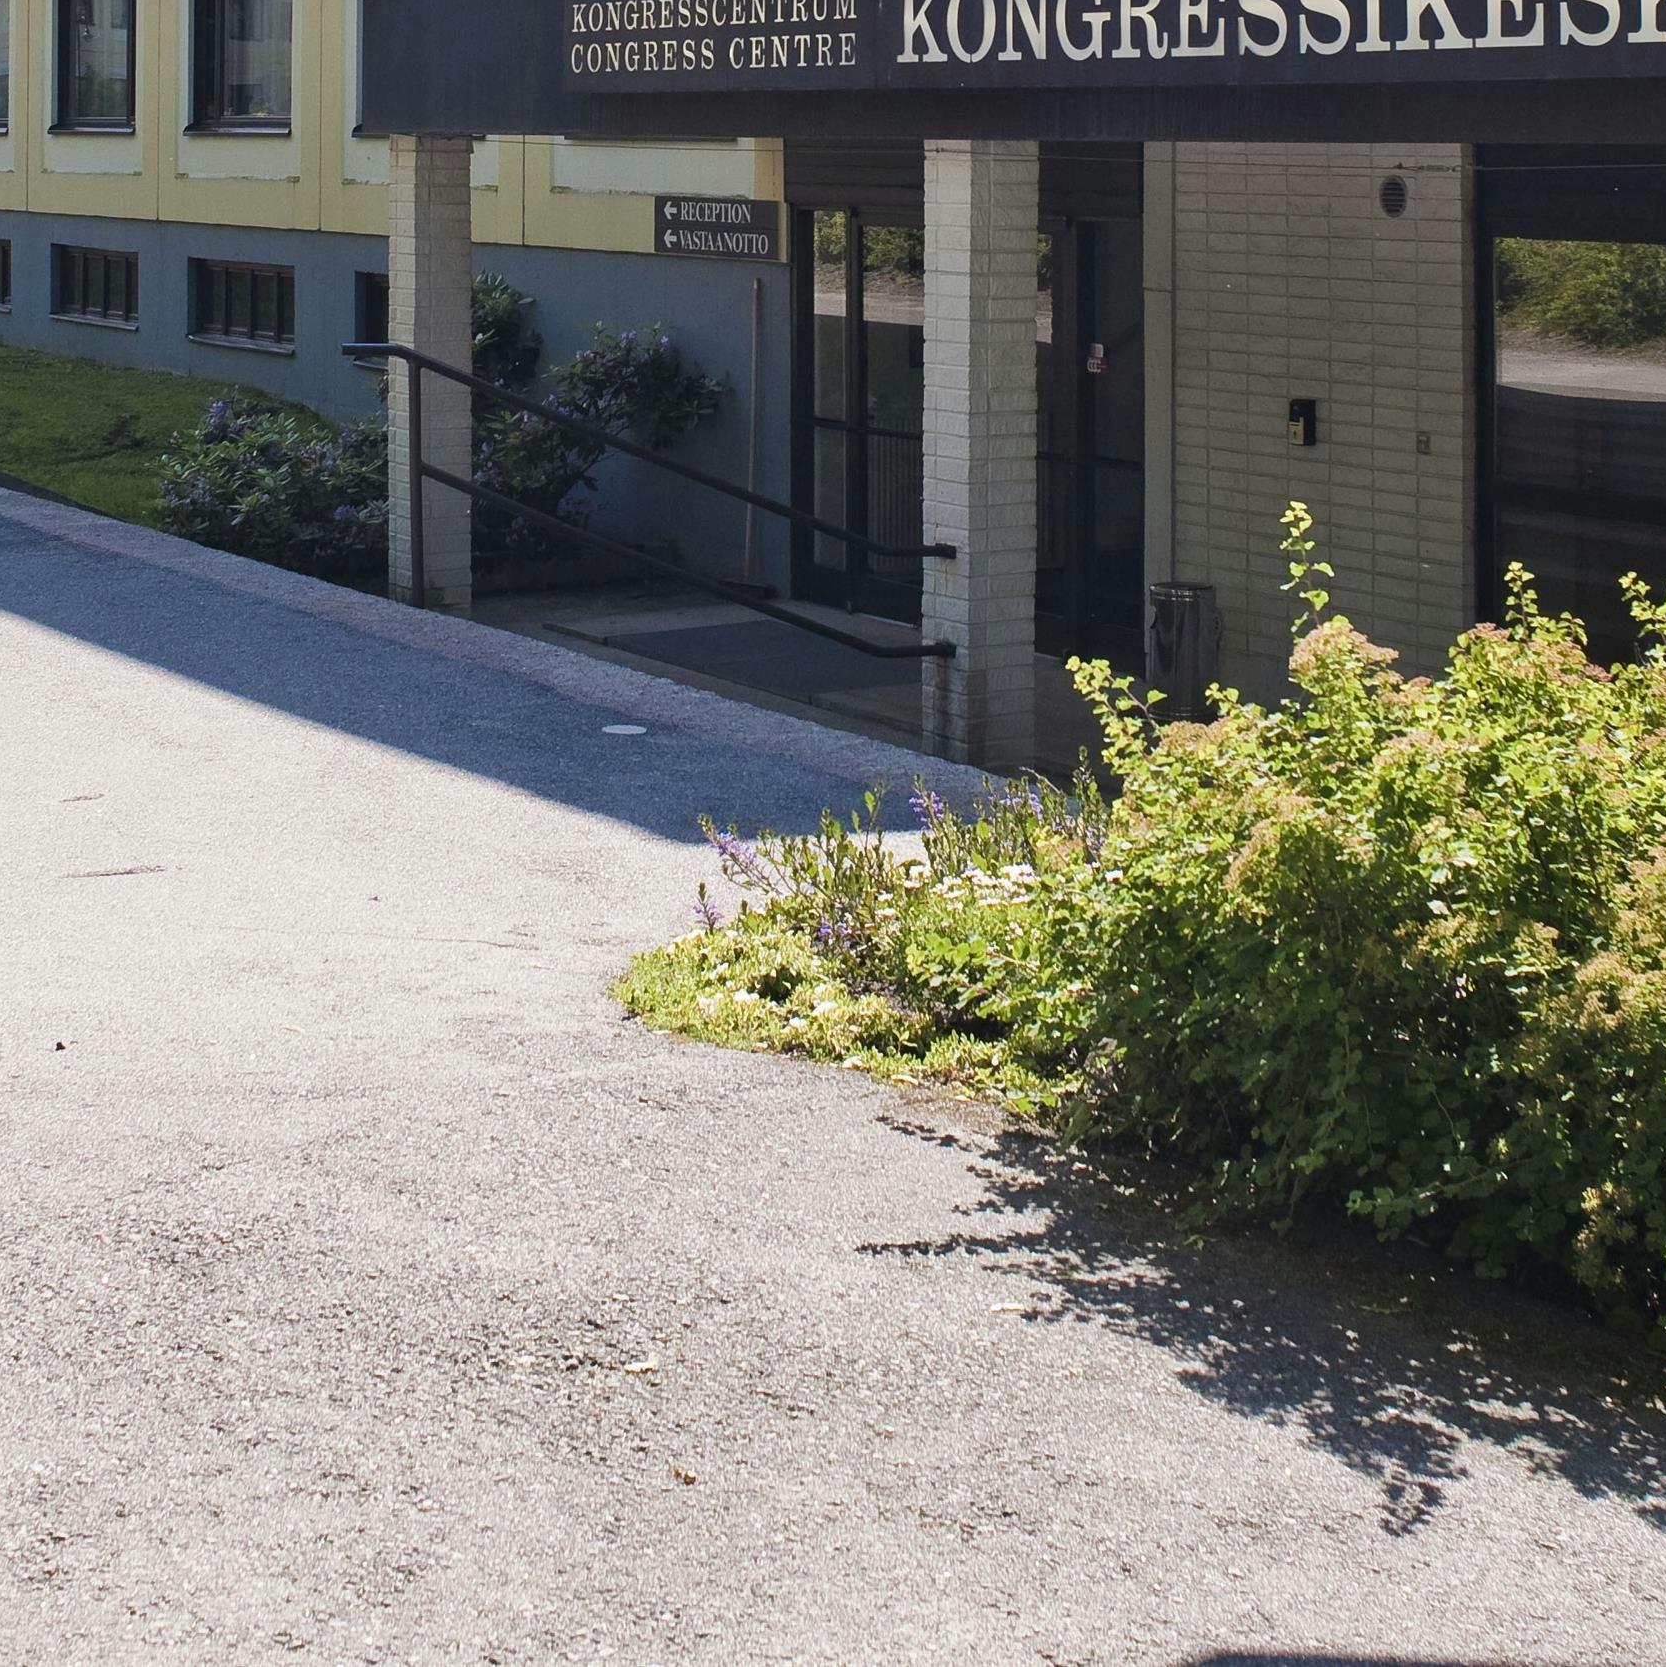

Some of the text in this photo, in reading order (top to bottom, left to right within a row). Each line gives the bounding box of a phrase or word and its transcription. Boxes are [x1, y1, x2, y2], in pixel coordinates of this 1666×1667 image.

[571, 32, 856, 74] CONGRESS CENTRE
[680, 201, 751, 224] RECEPTION
[678, 229, 769, 255] VASTAANOTTO
